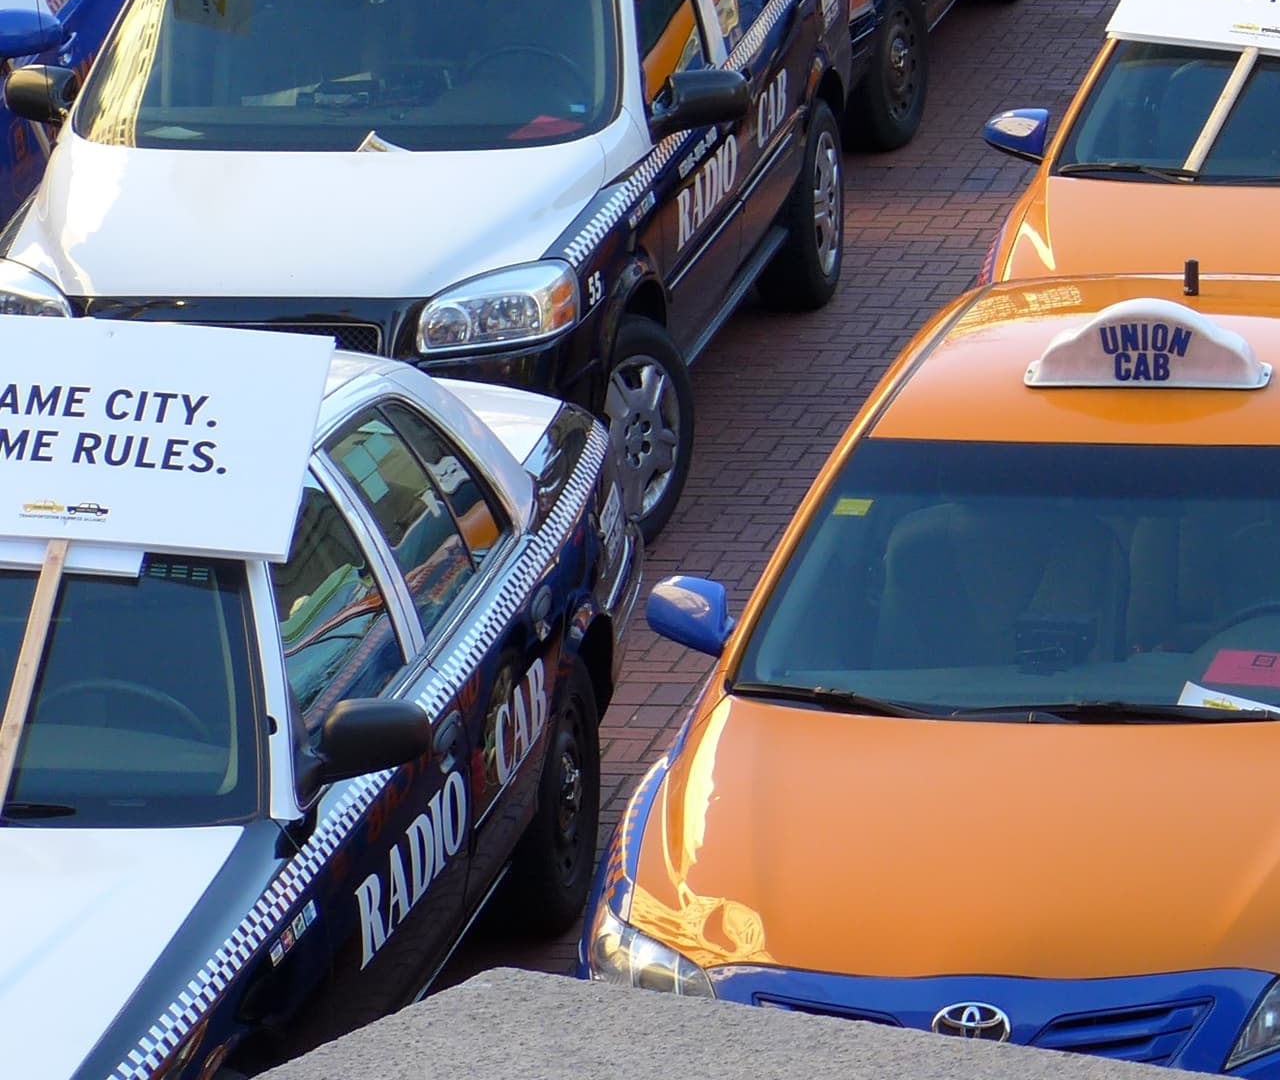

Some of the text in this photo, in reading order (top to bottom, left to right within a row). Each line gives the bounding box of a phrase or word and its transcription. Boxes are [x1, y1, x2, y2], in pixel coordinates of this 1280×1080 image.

[757, 68, 788, 150] CAB
[676, 134, 738, 252] RADIO
[588, 271, 603, 306] 55
[1099, 325, 1192, 357] UNION
[1114, 351, 1170, 382] CAB
[0, 384, 217, 428] AME CITY.
[0, 429, 226, 475] ME RULES.
[495, 658, 547, 786] CAB
[356, 771, 467, 972] RADIO
